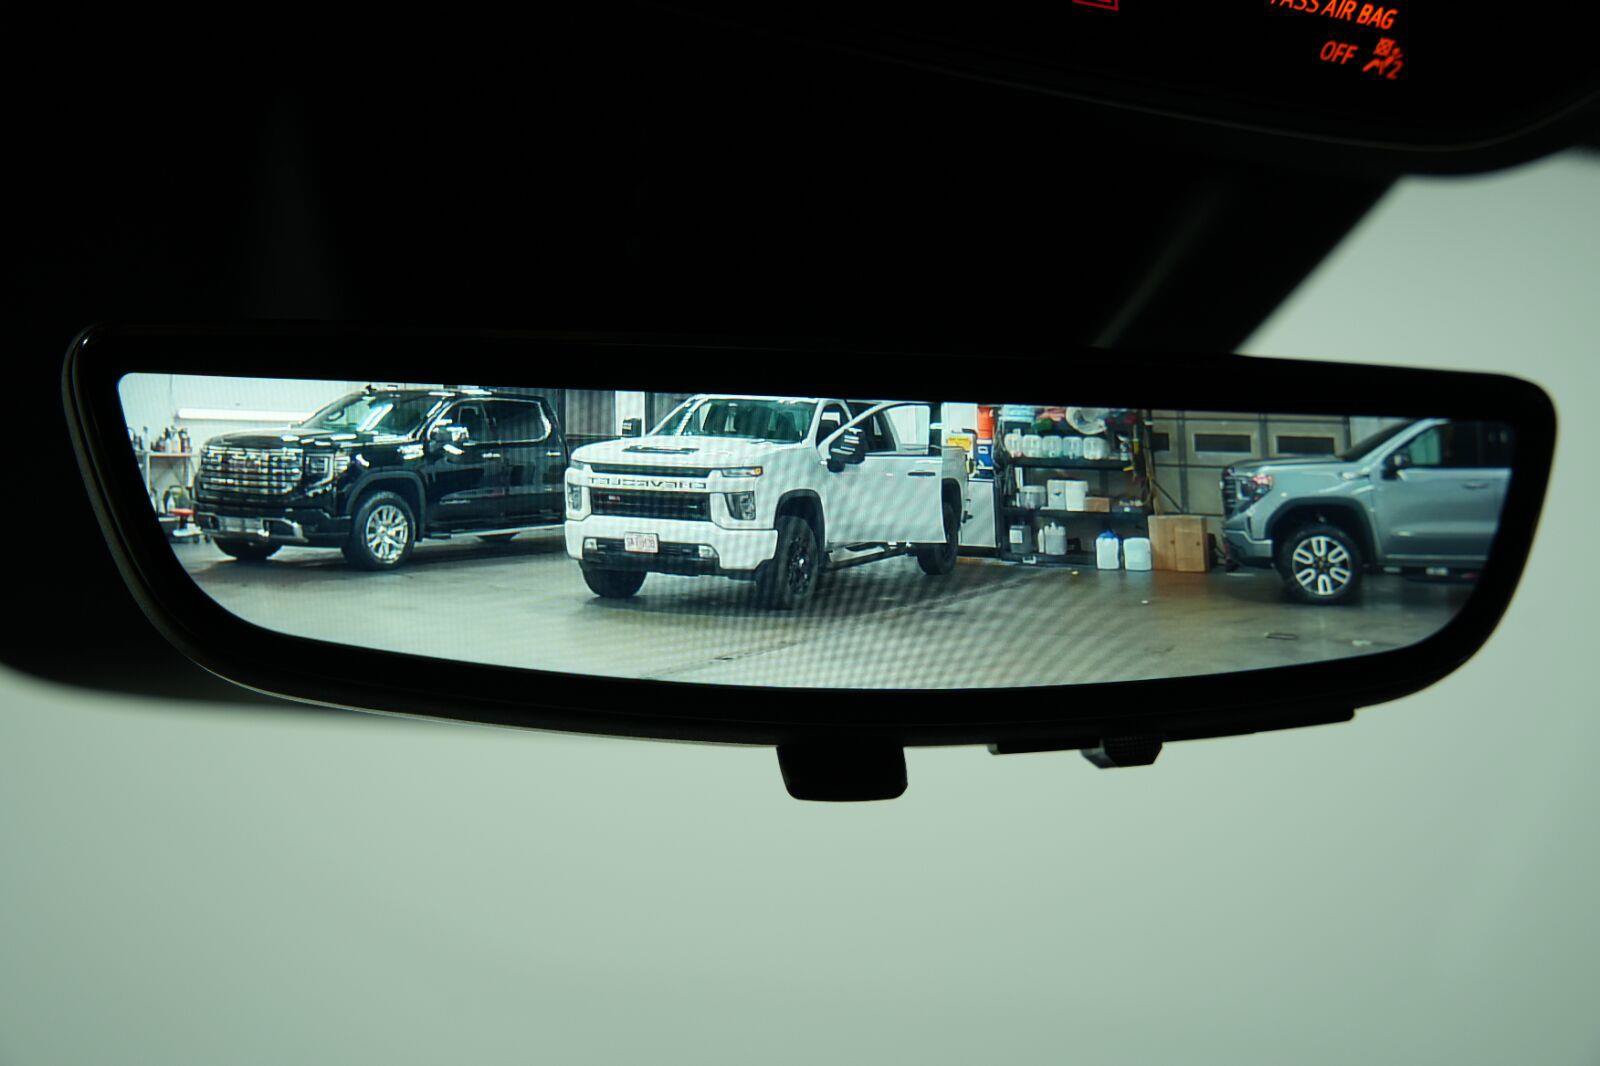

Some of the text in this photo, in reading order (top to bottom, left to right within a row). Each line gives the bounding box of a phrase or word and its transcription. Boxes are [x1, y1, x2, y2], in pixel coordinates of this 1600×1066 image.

[1271, 0, 1398, 29] ASS AIR BAG
[1320, 41, 1358, 64] OFF
